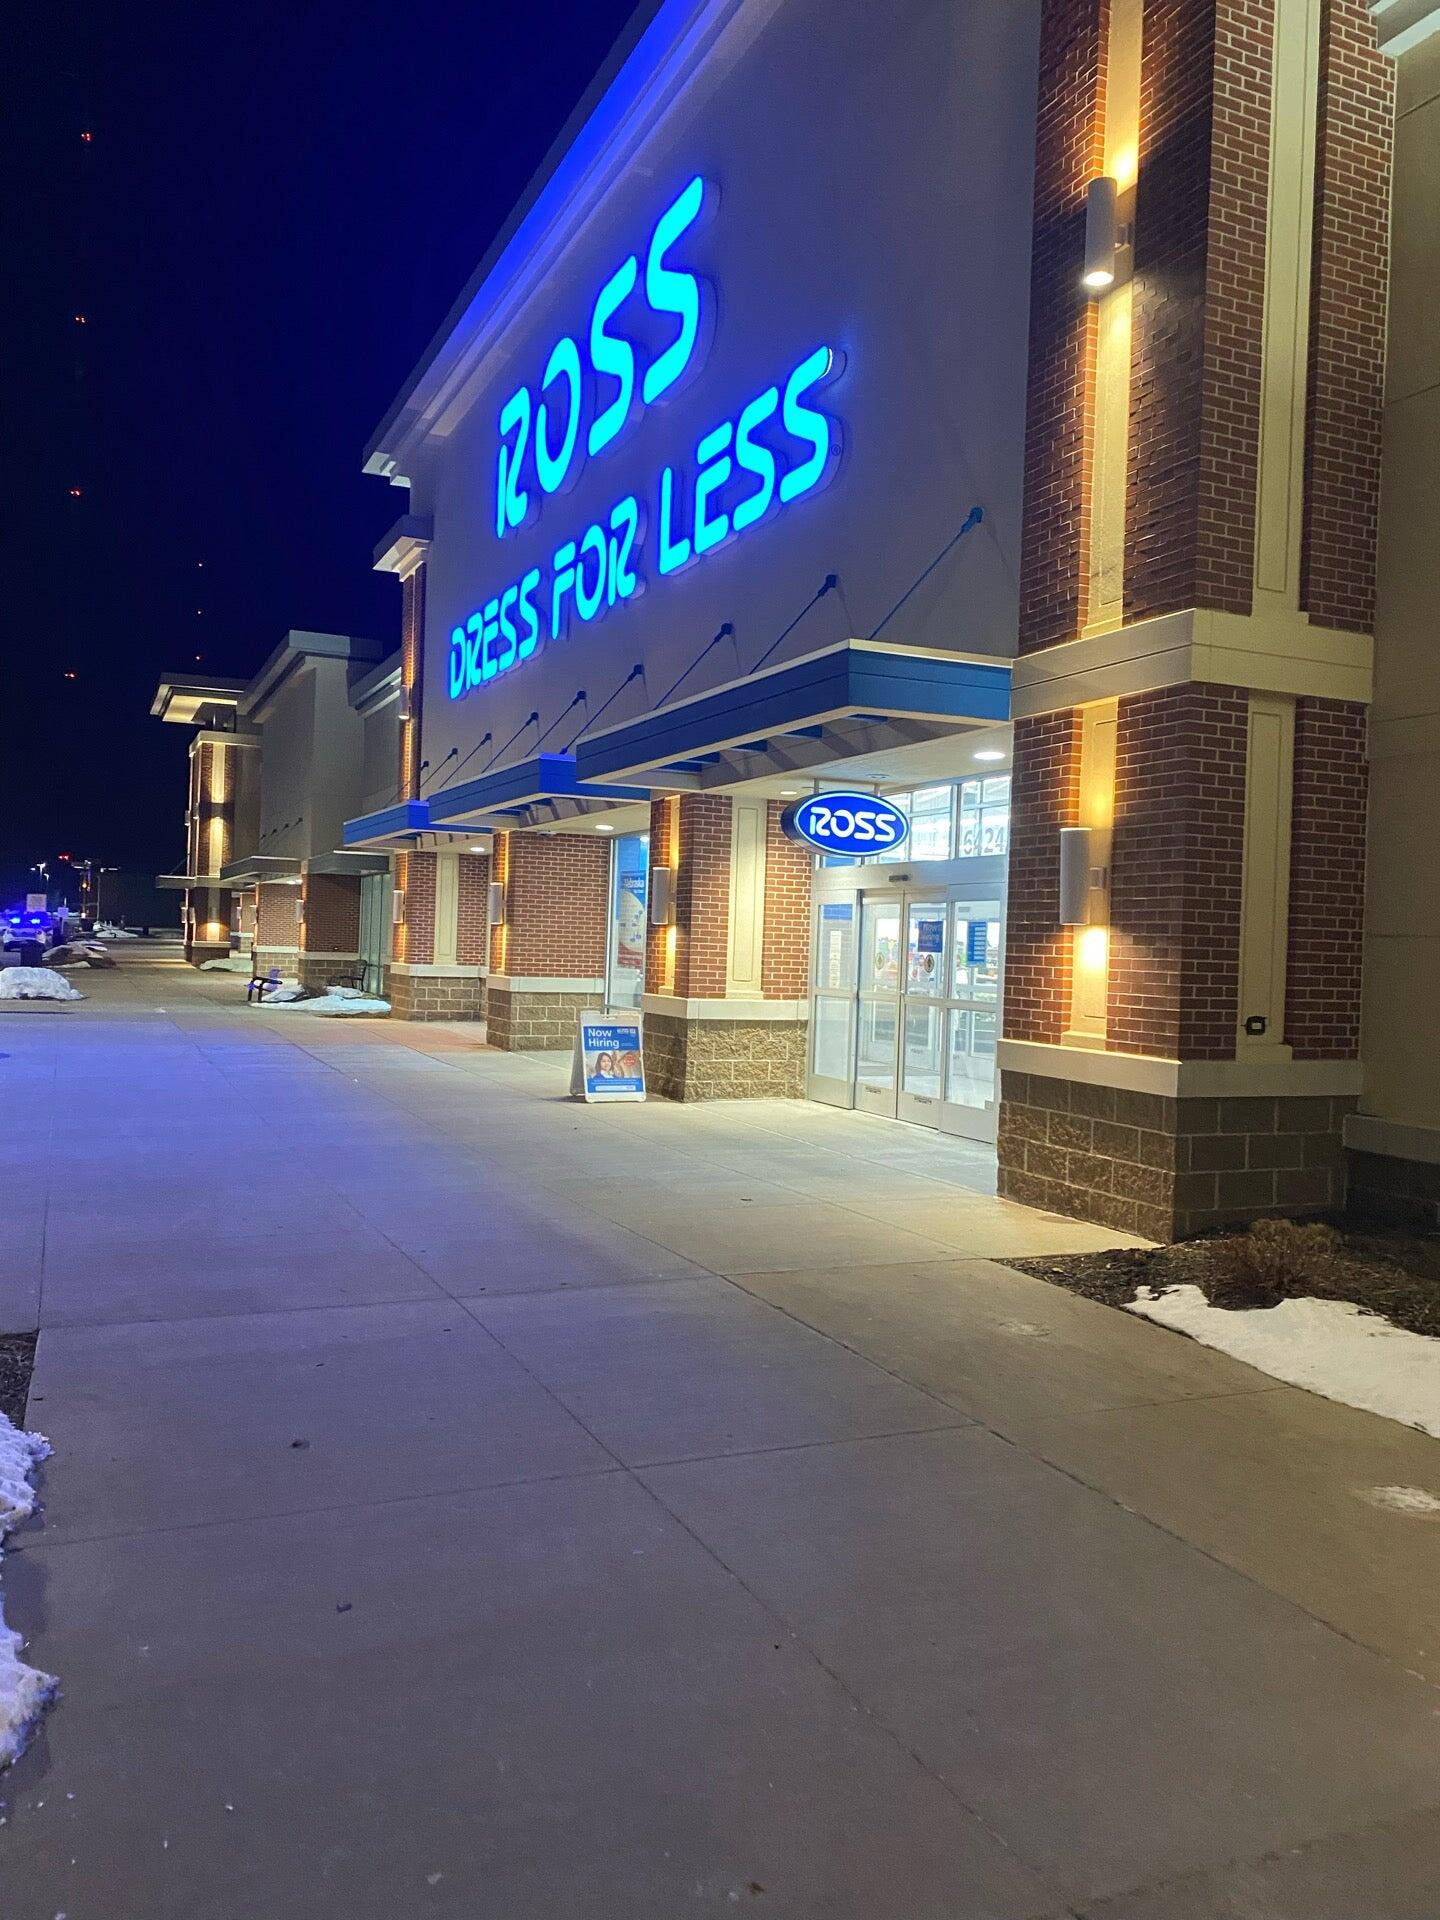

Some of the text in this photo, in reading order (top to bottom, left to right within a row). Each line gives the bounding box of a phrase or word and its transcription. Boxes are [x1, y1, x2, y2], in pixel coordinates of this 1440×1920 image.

[496, 177, 703, 538] ROSS
[451, 347, 834, 698] DRESS FOR LESS
[809, 806, 896, 842] ROSS
[588, 1028, 612, 1037] Now
[588, 1038, 620, 1049] Hiring
